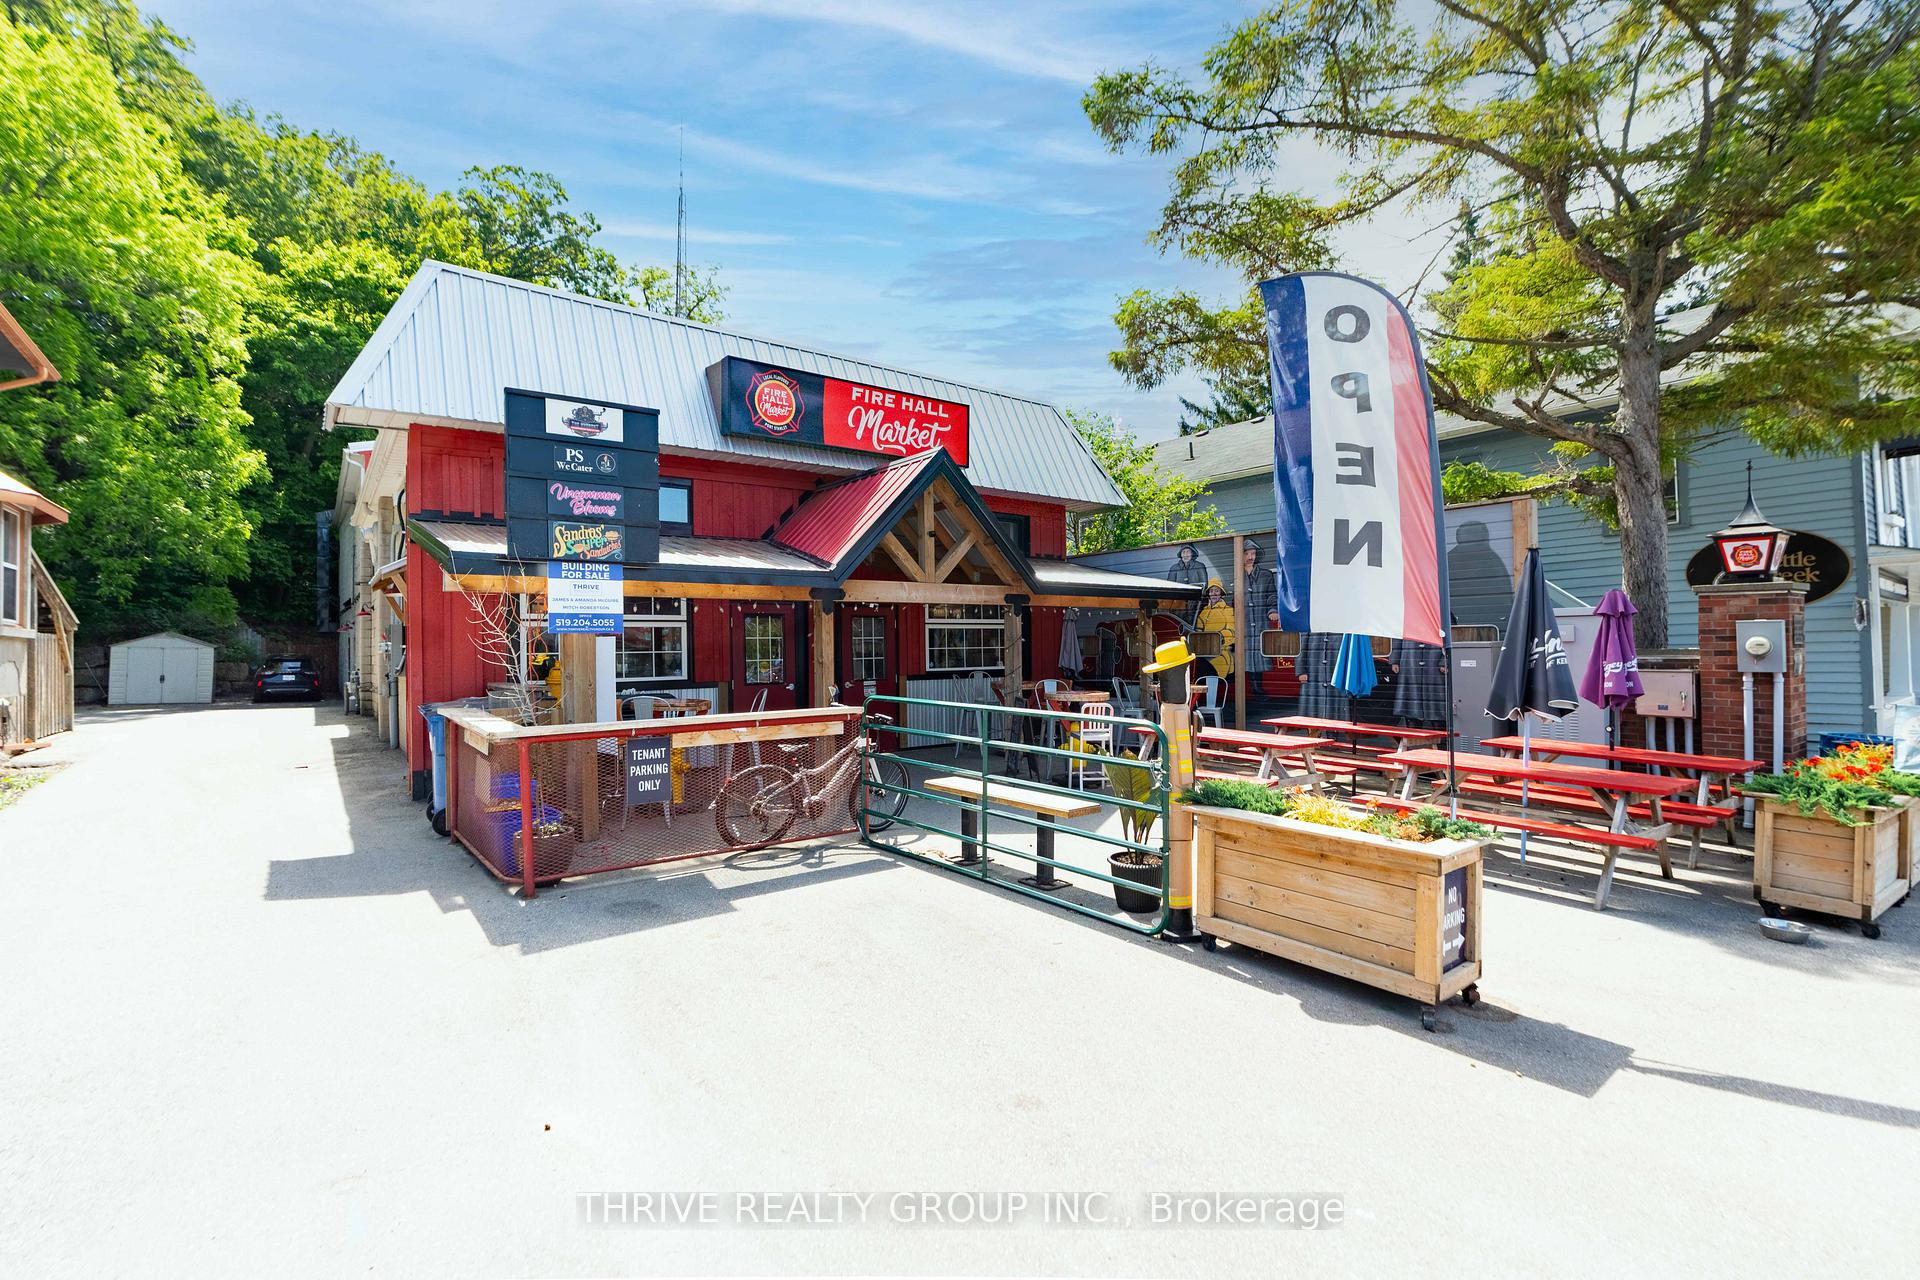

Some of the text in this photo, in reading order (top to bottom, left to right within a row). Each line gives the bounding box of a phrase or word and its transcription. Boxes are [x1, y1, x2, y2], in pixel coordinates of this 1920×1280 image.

[761, 393, 790, 406] HALL
[764, 387, 788, 398] FIRE
[760, 401, 793, 417] Market
[851, 386, 949, 418] FIRE HALL
[847, 405, 952, 455] Market
[565, 448, 584, 463] PS
[556, 461, 594, 473] We Cater
[550, 483, 621, 501] Uncommon
[569, 498, 617, 517] Blooms
[561, 562, 610, 572] BUILDING
[561, 571, 610, 580] FOR SALE
[555, 618, 615, 627] 519.204.5055
[632, 748, 666, 760] TENANT
[630, 763, 669, 777] PARKING
[639, 779, 661, 791] ONLY
[1448, 886, 1457, 904] NO
[1444, 907, 1465, 930] ARKING
